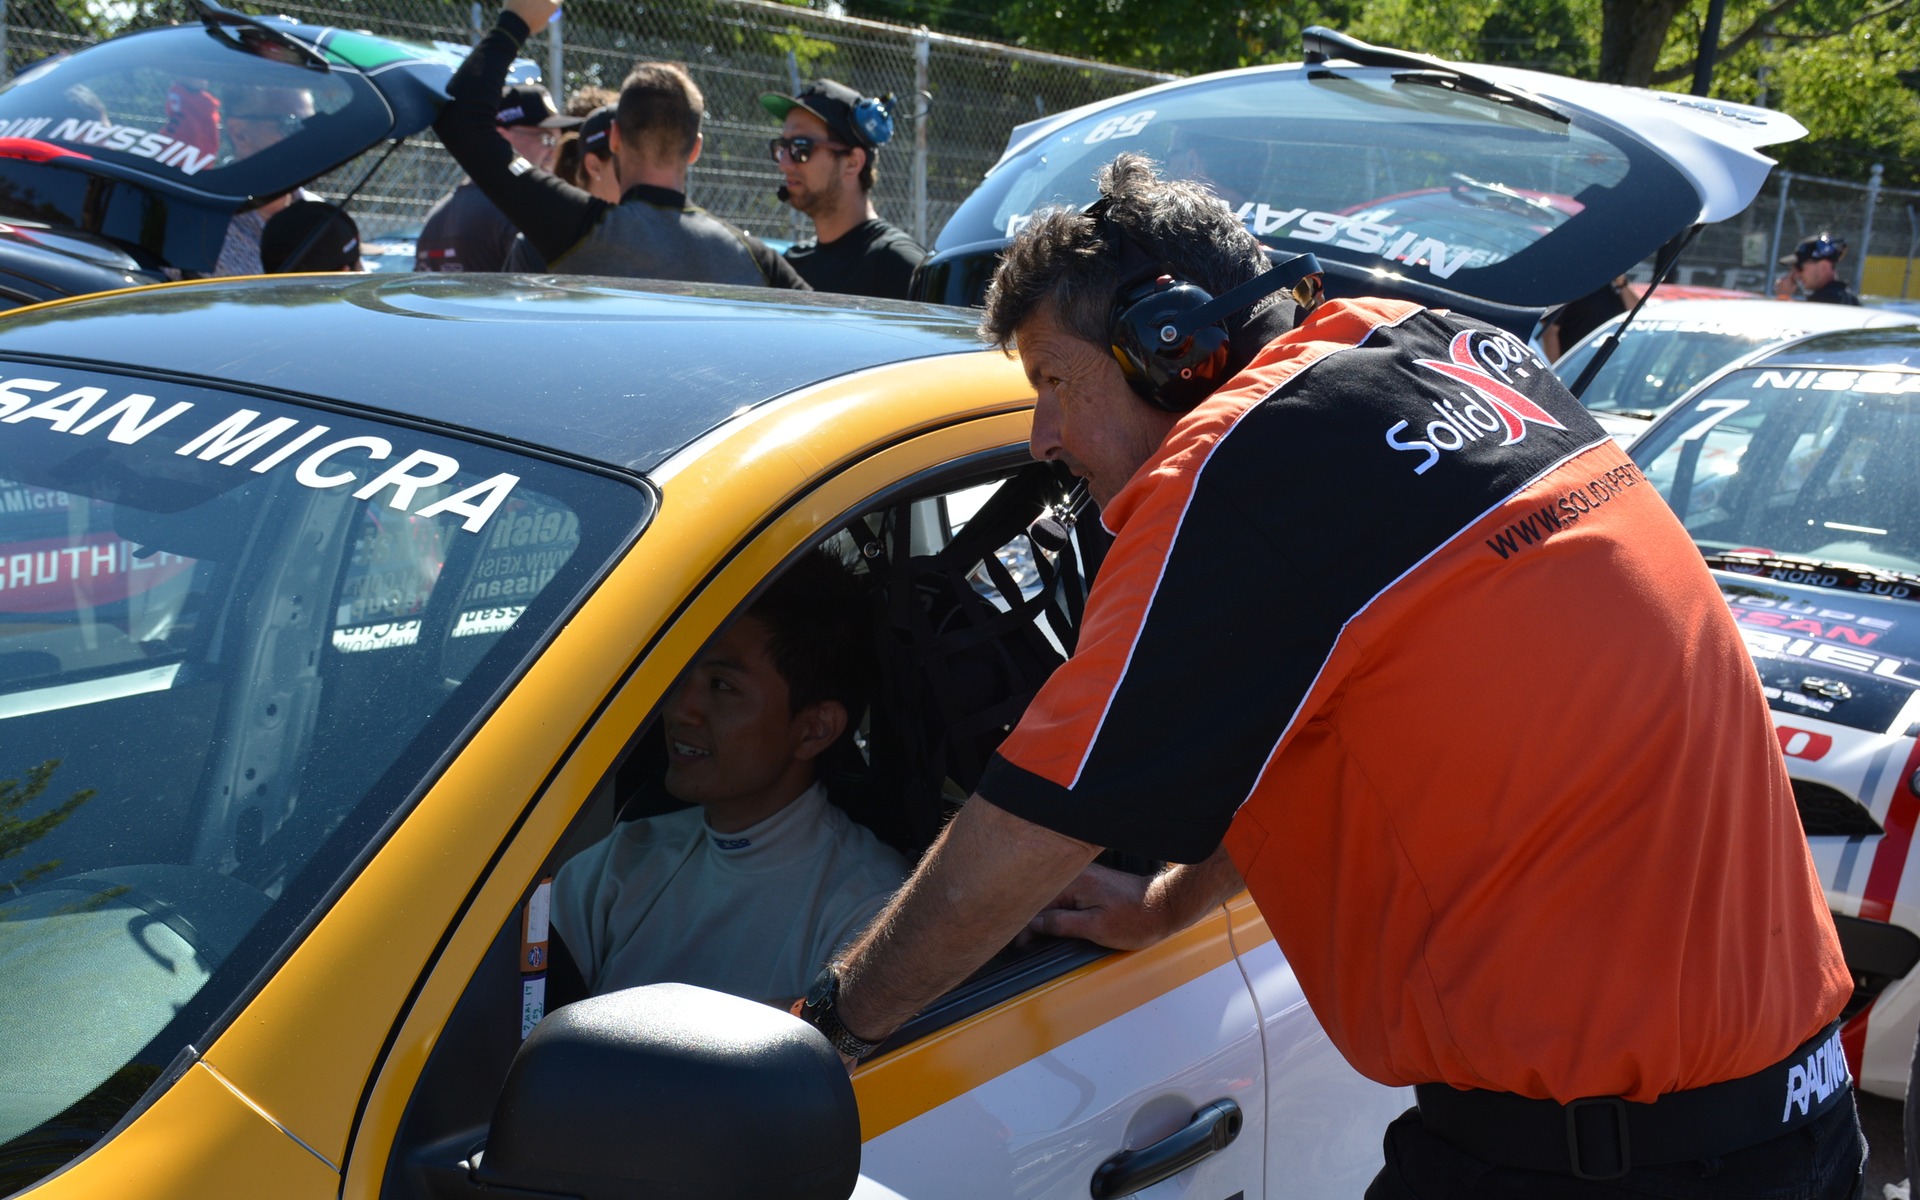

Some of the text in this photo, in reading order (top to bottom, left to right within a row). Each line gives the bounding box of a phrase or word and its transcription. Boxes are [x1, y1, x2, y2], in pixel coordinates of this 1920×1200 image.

[48, 117, 216, 176] NISSAN
[1083, 110, 1157, 145] 59
[1679, 399, 1750, 441] 7
[175, 409, 520, 533] MICRA
[1485, 462, 1648, 560] WWW.SOLIDXPERT
[1770, 568, 1838, 588] NORD
[1857, 581, 1910, 599] SUD
